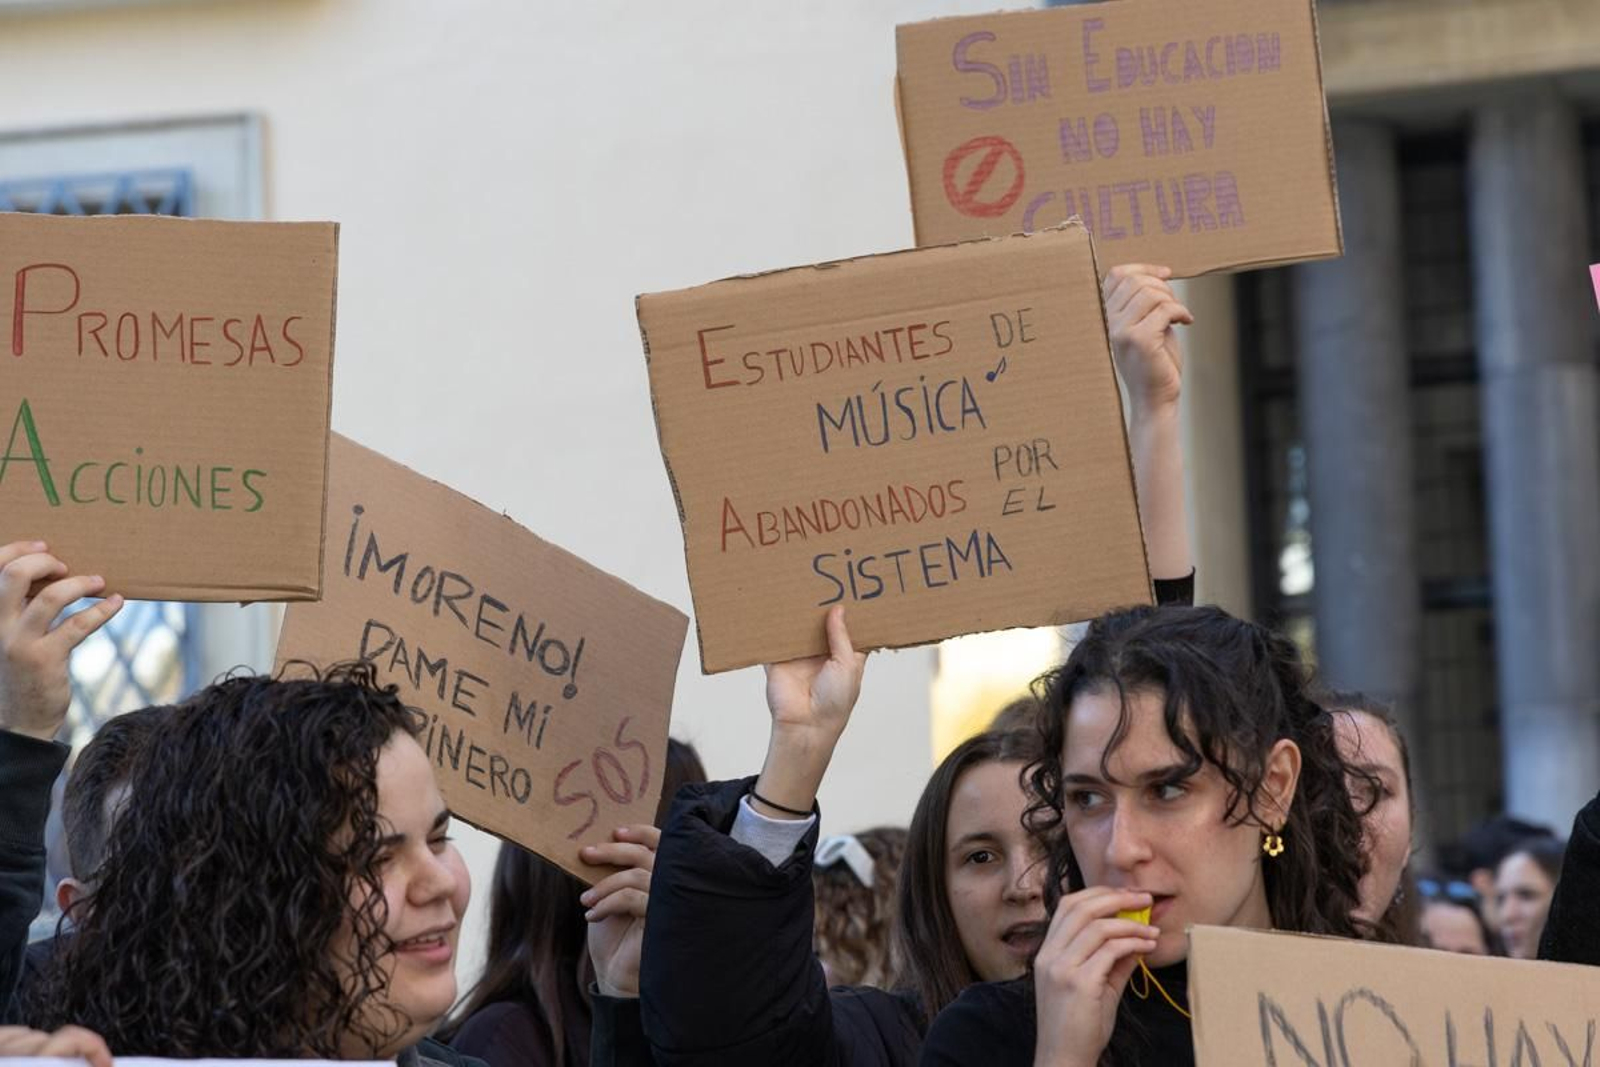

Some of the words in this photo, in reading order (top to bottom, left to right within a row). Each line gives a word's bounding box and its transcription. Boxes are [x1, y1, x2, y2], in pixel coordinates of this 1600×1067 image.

[953, 30, 1051, 111] SIN
[1082, 17, 1282, 94] EDUCACION
[1058, 112, 1120, 164] NO
[1139, 104, 1217, 159] HAY
[12, 263, 305, 367] PROMESAS
[697, 320, 954, 390] ESTUDIANTES
[990, 307, 1037, 349] DE
[993, 438, 1059, 481] POR
[1001, 486, 1057, 516] EL
[720, 480, 968, 553] ABANDONADOS
[360, 618, 490, 718] DAME
[553, 715, 651, 841] SOS
